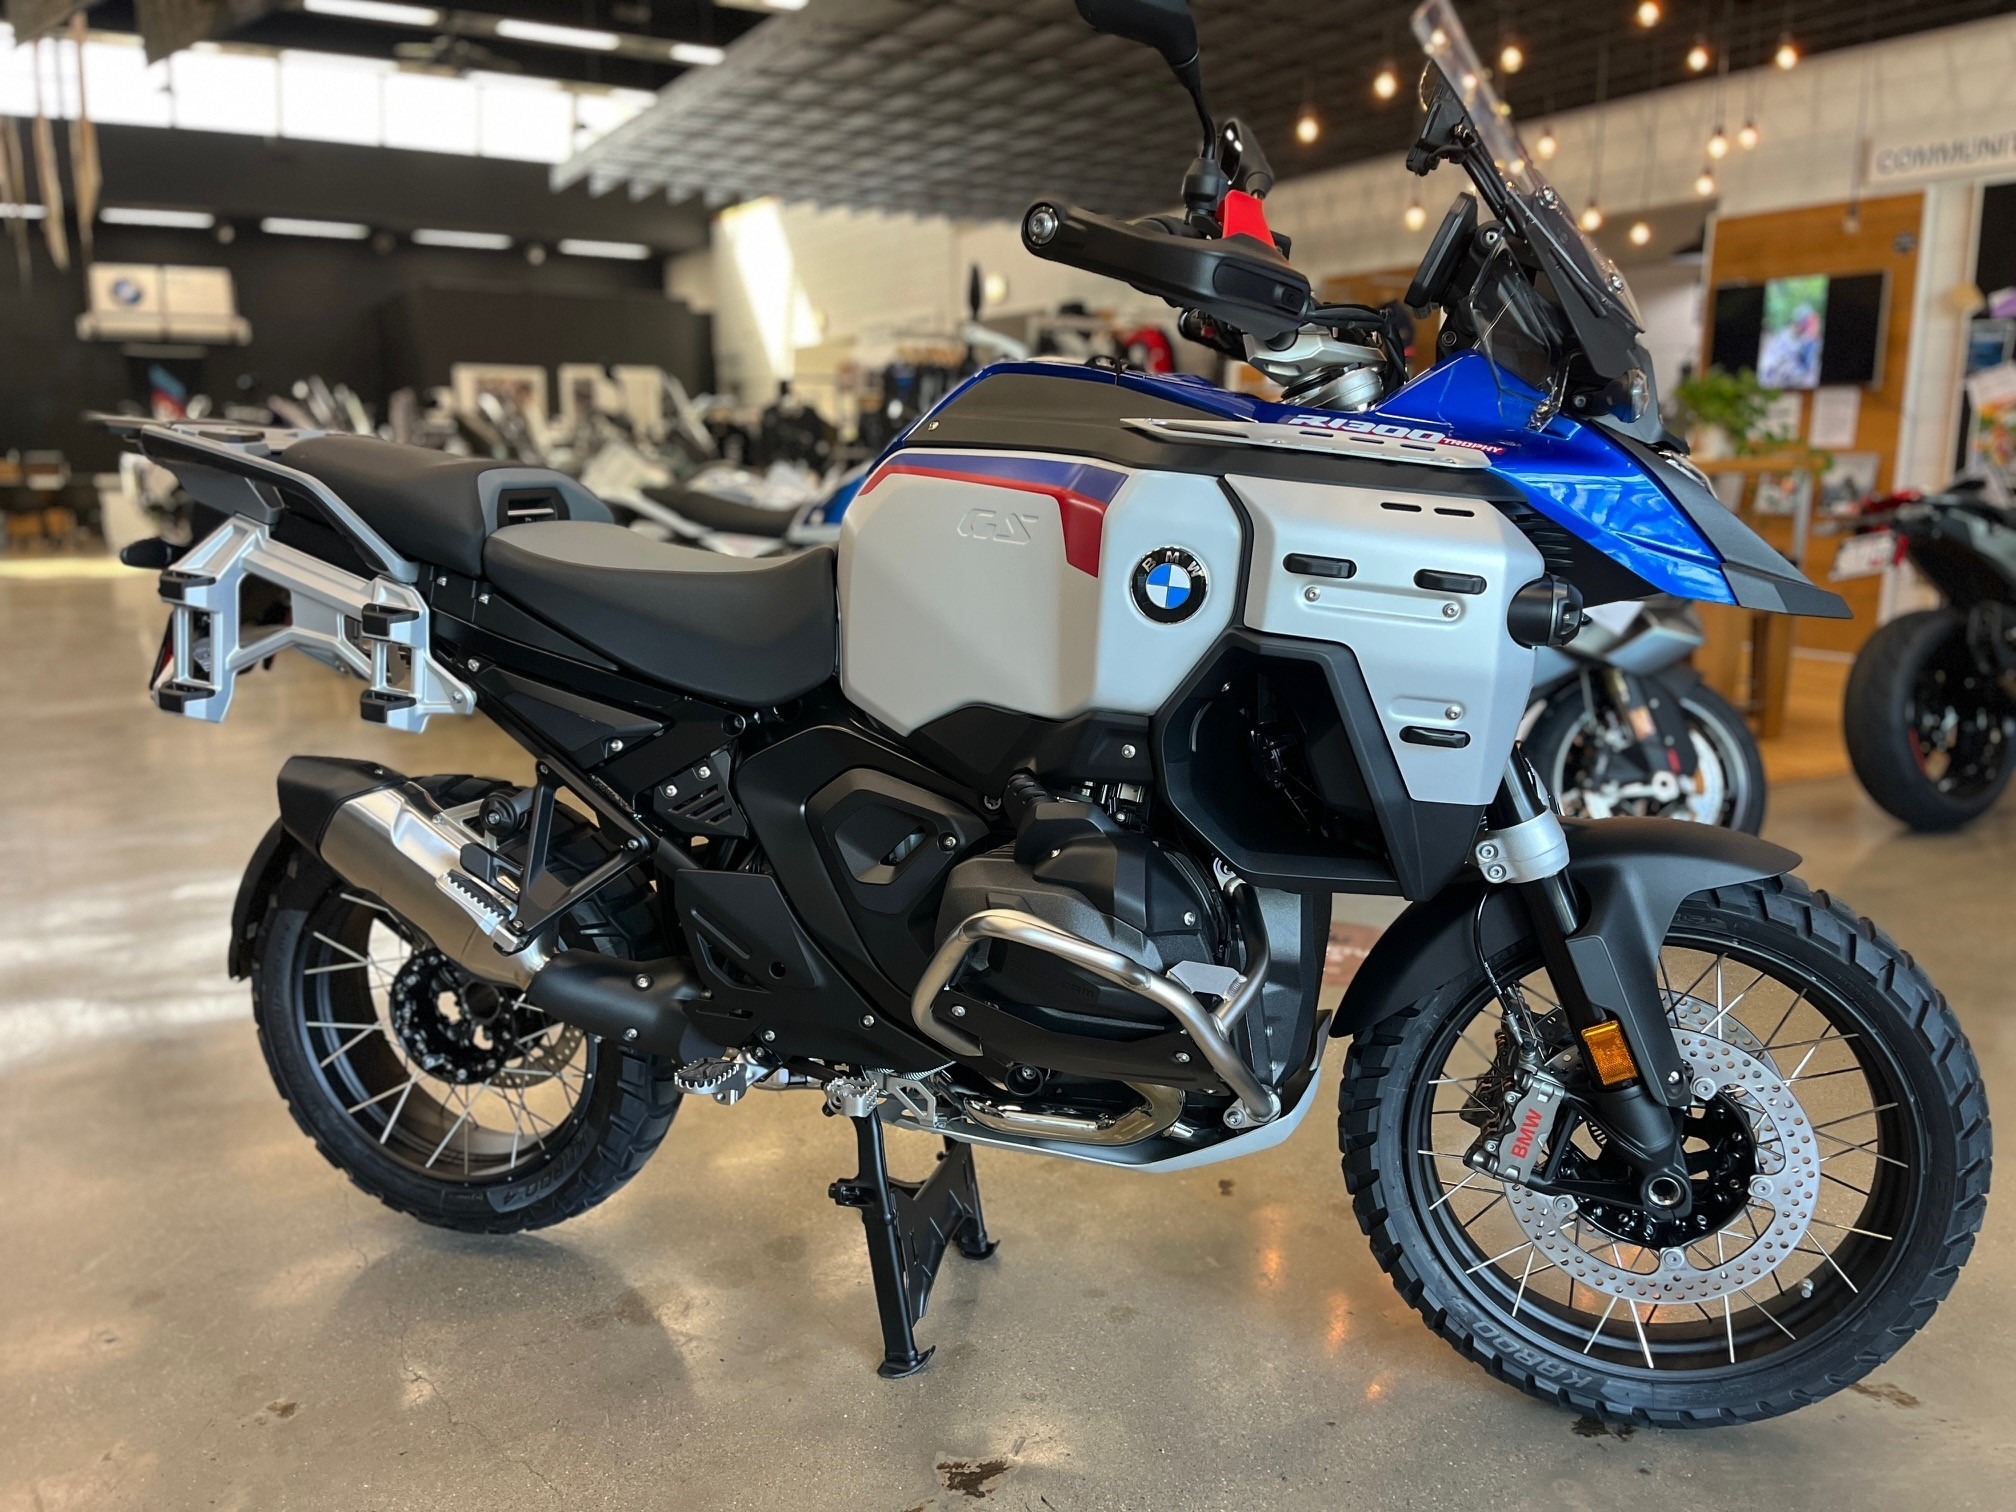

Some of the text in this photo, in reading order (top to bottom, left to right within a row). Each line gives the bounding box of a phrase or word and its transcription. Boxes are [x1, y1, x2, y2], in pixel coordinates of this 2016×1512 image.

[1288, 414, 1503, 453] R1300 TROPHY
[957, 508, 1039, 545] GS
[1141, 550, 1206, 578] BMW
[1510, 1107, 1543, 1159] BMW
[1472, 1321, 1593, 1388] KAROO
